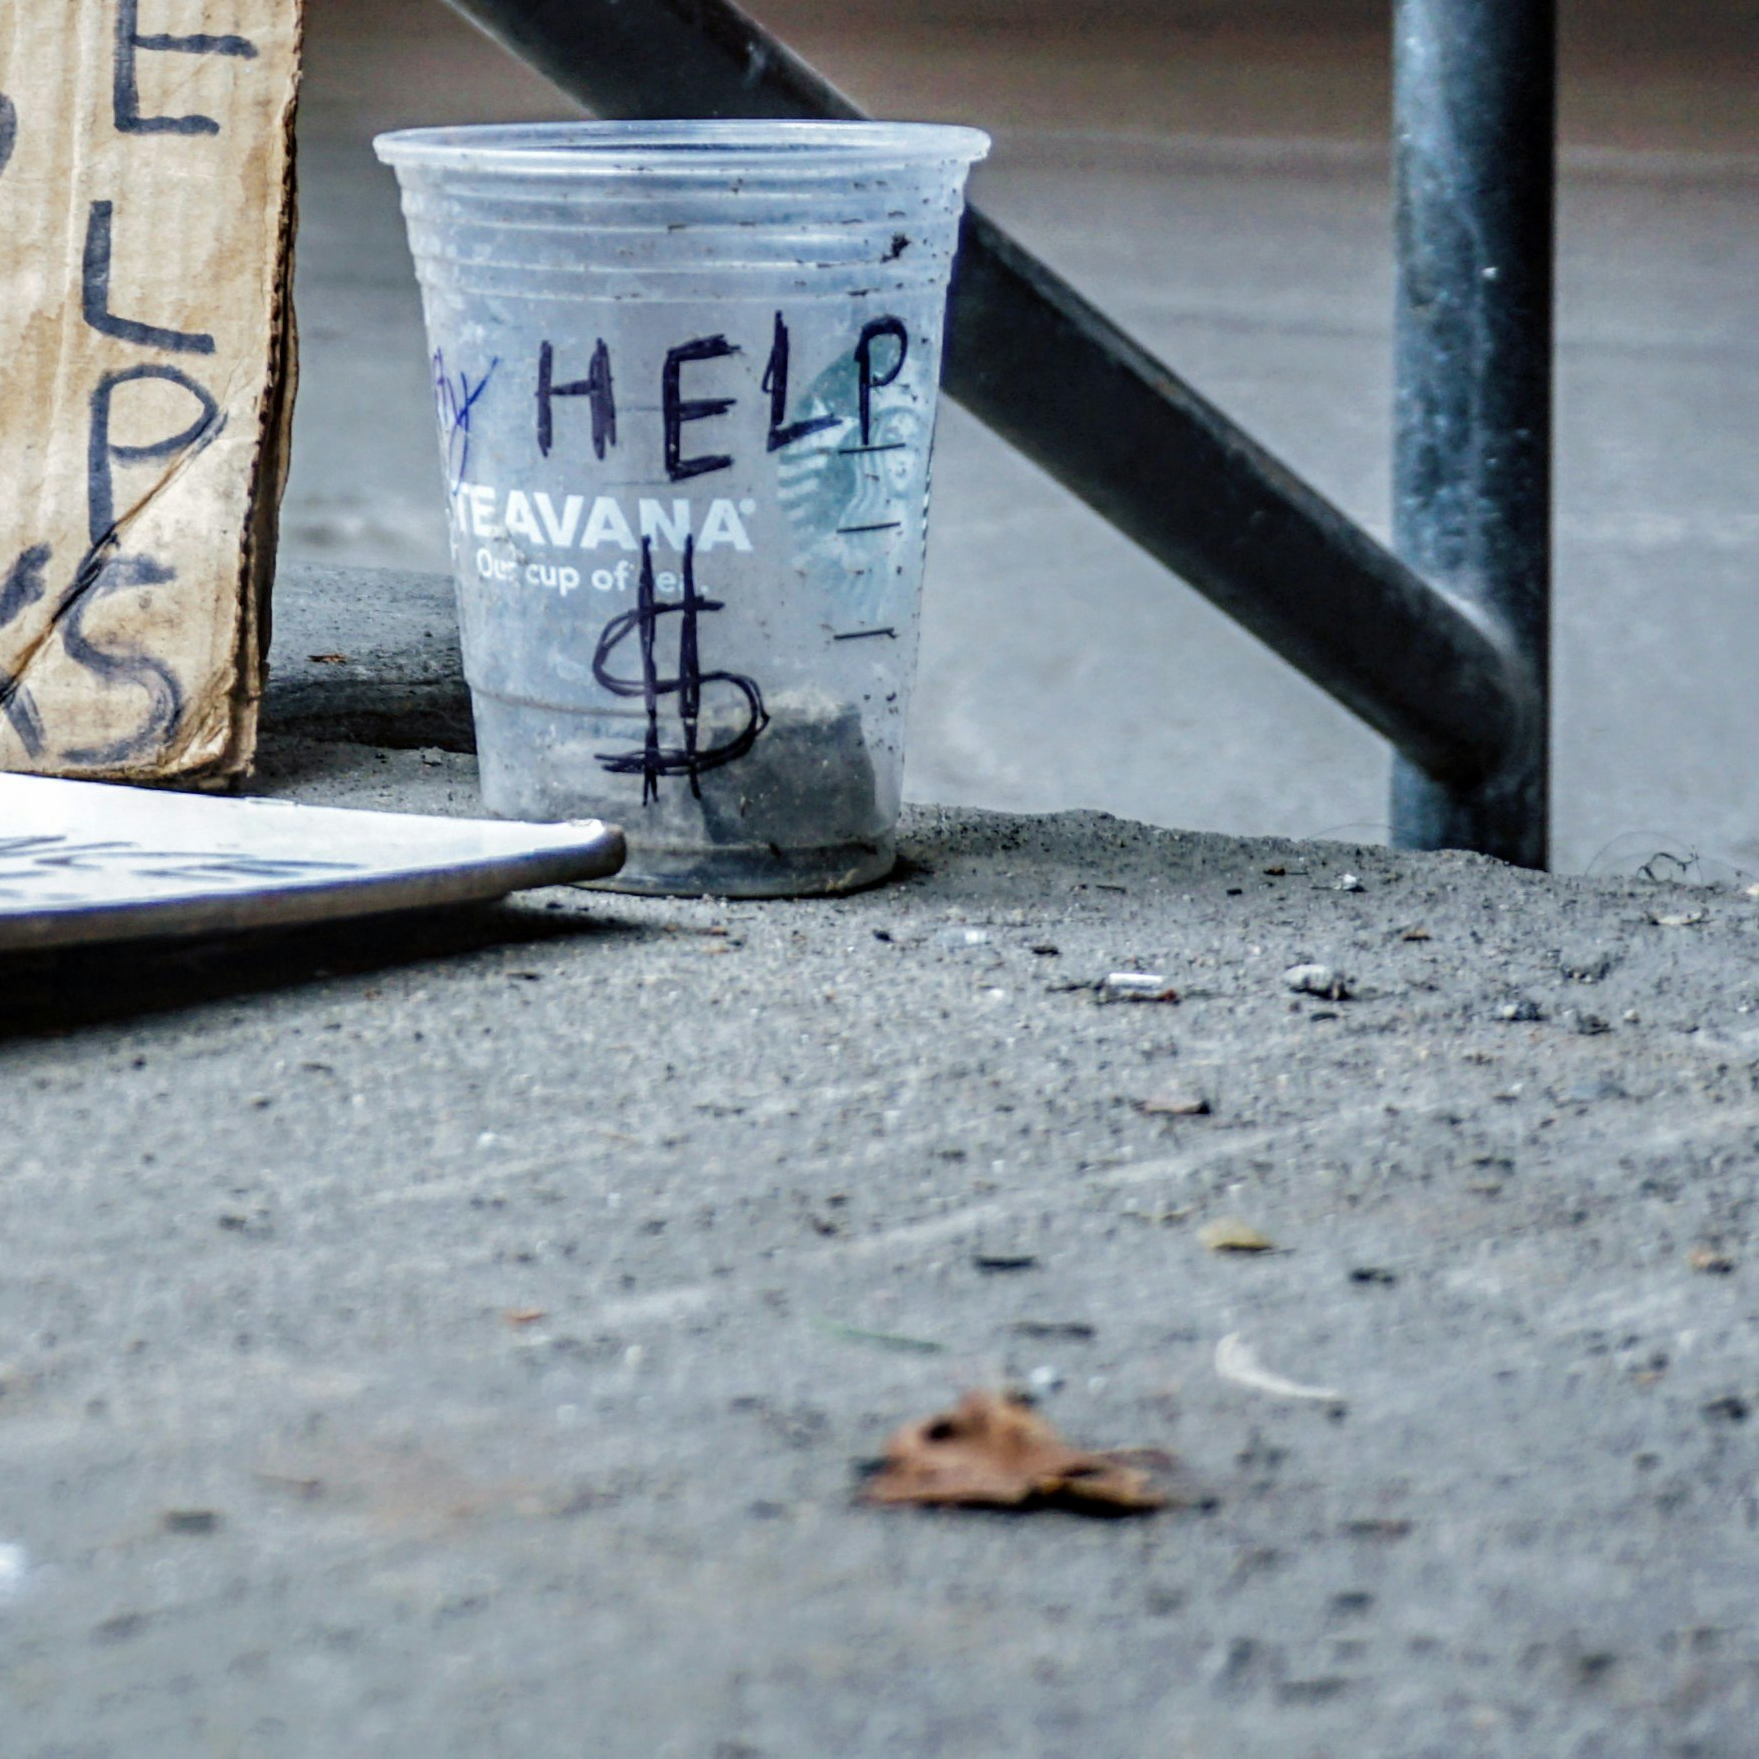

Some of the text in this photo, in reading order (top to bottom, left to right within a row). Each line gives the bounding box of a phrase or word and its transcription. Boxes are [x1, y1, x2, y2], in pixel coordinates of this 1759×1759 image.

[535, 309, 909, 483] HELP
[524, 560, 581, 597] cup
[591, 560, 631, 593] of
[591, 533, 771, 807] $
